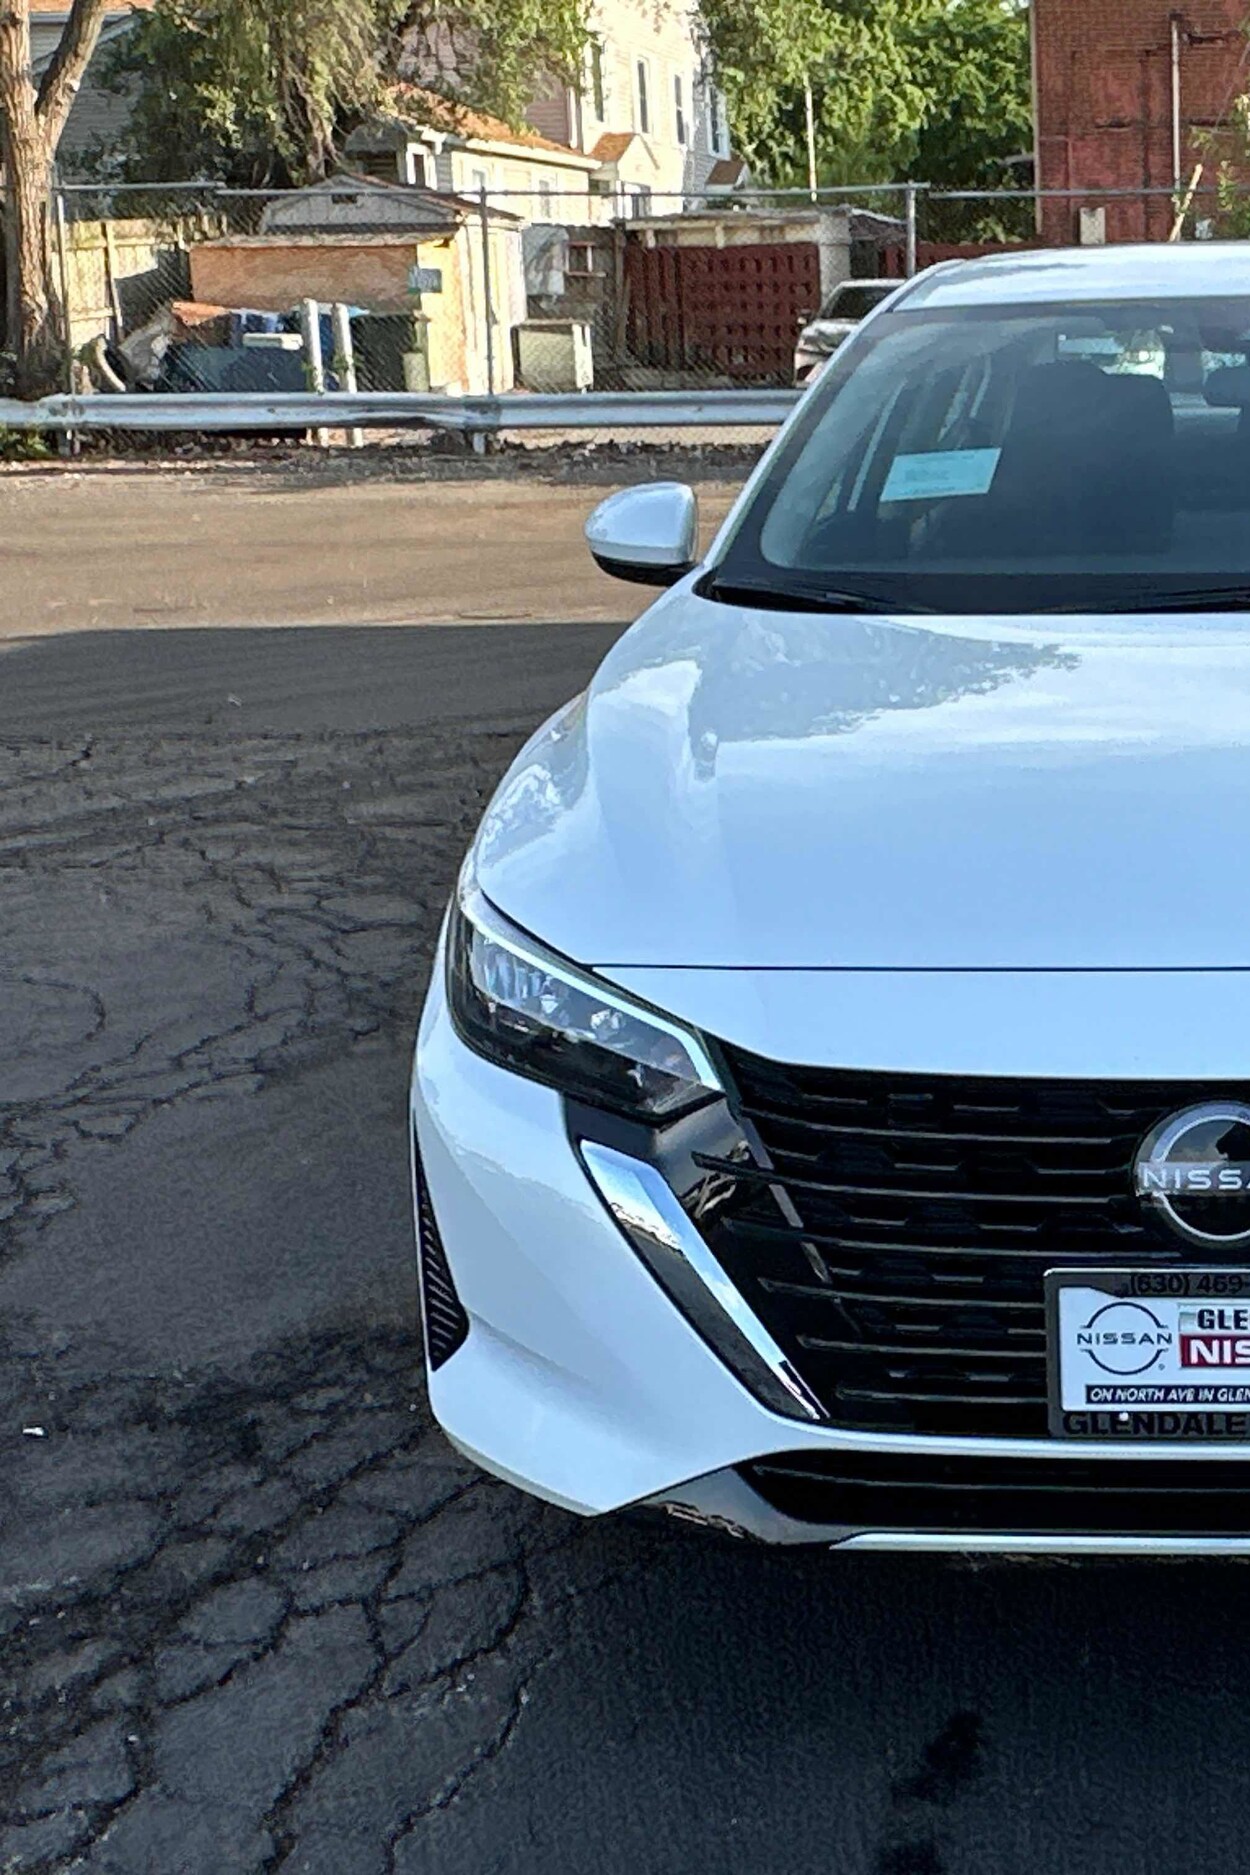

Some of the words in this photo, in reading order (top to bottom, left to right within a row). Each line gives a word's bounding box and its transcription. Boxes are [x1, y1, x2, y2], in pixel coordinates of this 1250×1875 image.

[1130, 1274, 1190, 1295] (630)
[1077, 1332, 1173, 1346] NISSAN
[1090, 1387, 1113, 1402] ON
[1115, 1387, 1165, 1402] NORTH
[1166, 1387, 1195, 1402] AVE
[1197, 1387, 1215, 1402] IN
[1062, 1411, 1246, 1436] GLENDALE
